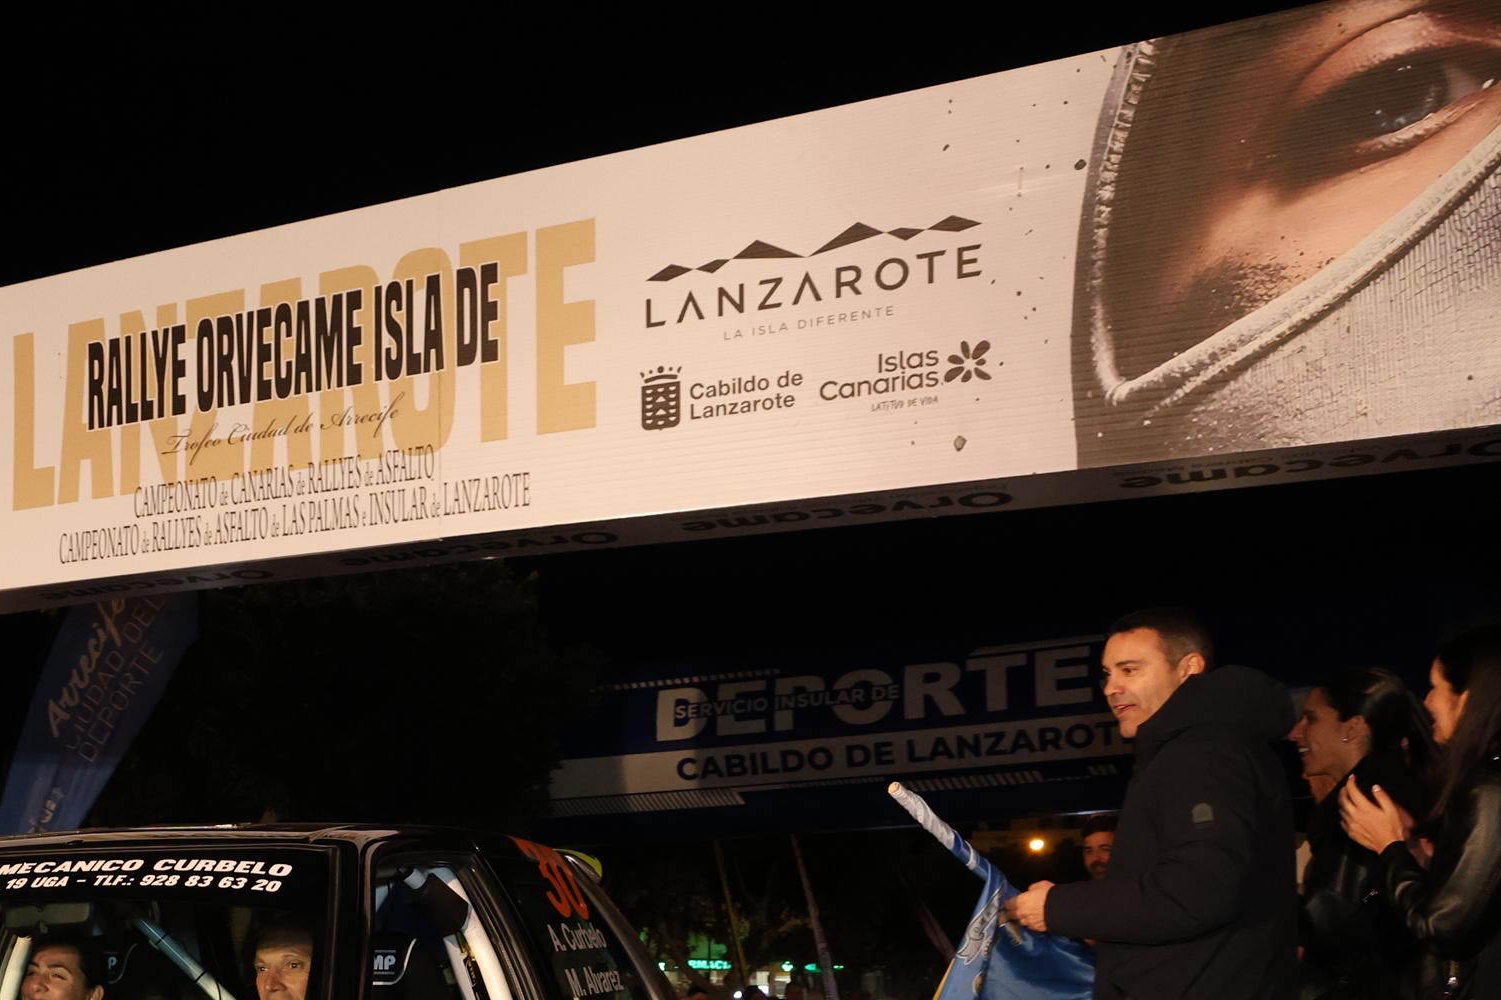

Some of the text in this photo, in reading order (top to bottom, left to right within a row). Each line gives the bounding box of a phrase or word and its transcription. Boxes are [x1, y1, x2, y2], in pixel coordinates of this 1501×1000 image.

[645, 243, 983, 328] LANZAROTE
[723, 305, 895, 342] LA ISLA DIFERENTE
[13, 218, 596, 511] LANZAROTE
[88, 262, 499, 430] RALLYE ORVECAME ISLA DE
[877, 348, 940, 374] Islas
[689, 370, 804, 400] Cabildo de
[819, 370, 941, 402] Canarias
[689, 393, 797, 421] Lanzarote
[161, 391, 406, 466] Trofeo Ciudad de Arrecife
[133, 475, 218, 519] CAMPEONATO
[220, 482, 229, 506] de
[230, 463, 295, 506] CANARIAS
[307, 454, 363, 494] RALLYES
[365, 462, 374, 486] de
[376, 443, 436, 486] ASFALTO
[59, 524, 140, 564] CAMPEONATO
[141, 530, 150, 554] de
[151, 515, 202, 553] RALLYES
[203, 521, 213, 547] de
[214, 506, 269, 546] ASFALTO
[271, 513, 280, 538] de
[282, 500, 306, 537] LAS
[308, 493, 360, 533] PALMAS
[369, 485, 429, 527] INSULAR
[431, 492, 441, 518] de
[443, 471, 532, 517] LANZAROTE
[681, 491, 1013, 533] Orvecame
[339, 531, 618, 567] Orvecame
[37, 569, 275, 600] Orvecame
[46, 596, 127, 738] Arrecife
[76, 639, 165, 763] DEPORTE
[655, 644, 1104, 742] DEPORTE
[674, 682, 901, 720] SERVICIO INSULAR DE
[676, 721, 1122, 782] CABILDO DE LANZAROT
[5, 878, 28, 890] 19
[31, 874, 69, 889] UGA
[93, 874, 135, 887] TLF.:
[140, 873, 177, 887] 928
[184, 874, 212, 888] 83
[217, 876, 247, 890] 63
[250, 878, 284, 893] 20
[153, 858, 293, 877] CURBELO
[546, 921, 608, 953] A. Curbelo
[373, 954, 397, 971] MP
[564, 967, 588, 997] M.
